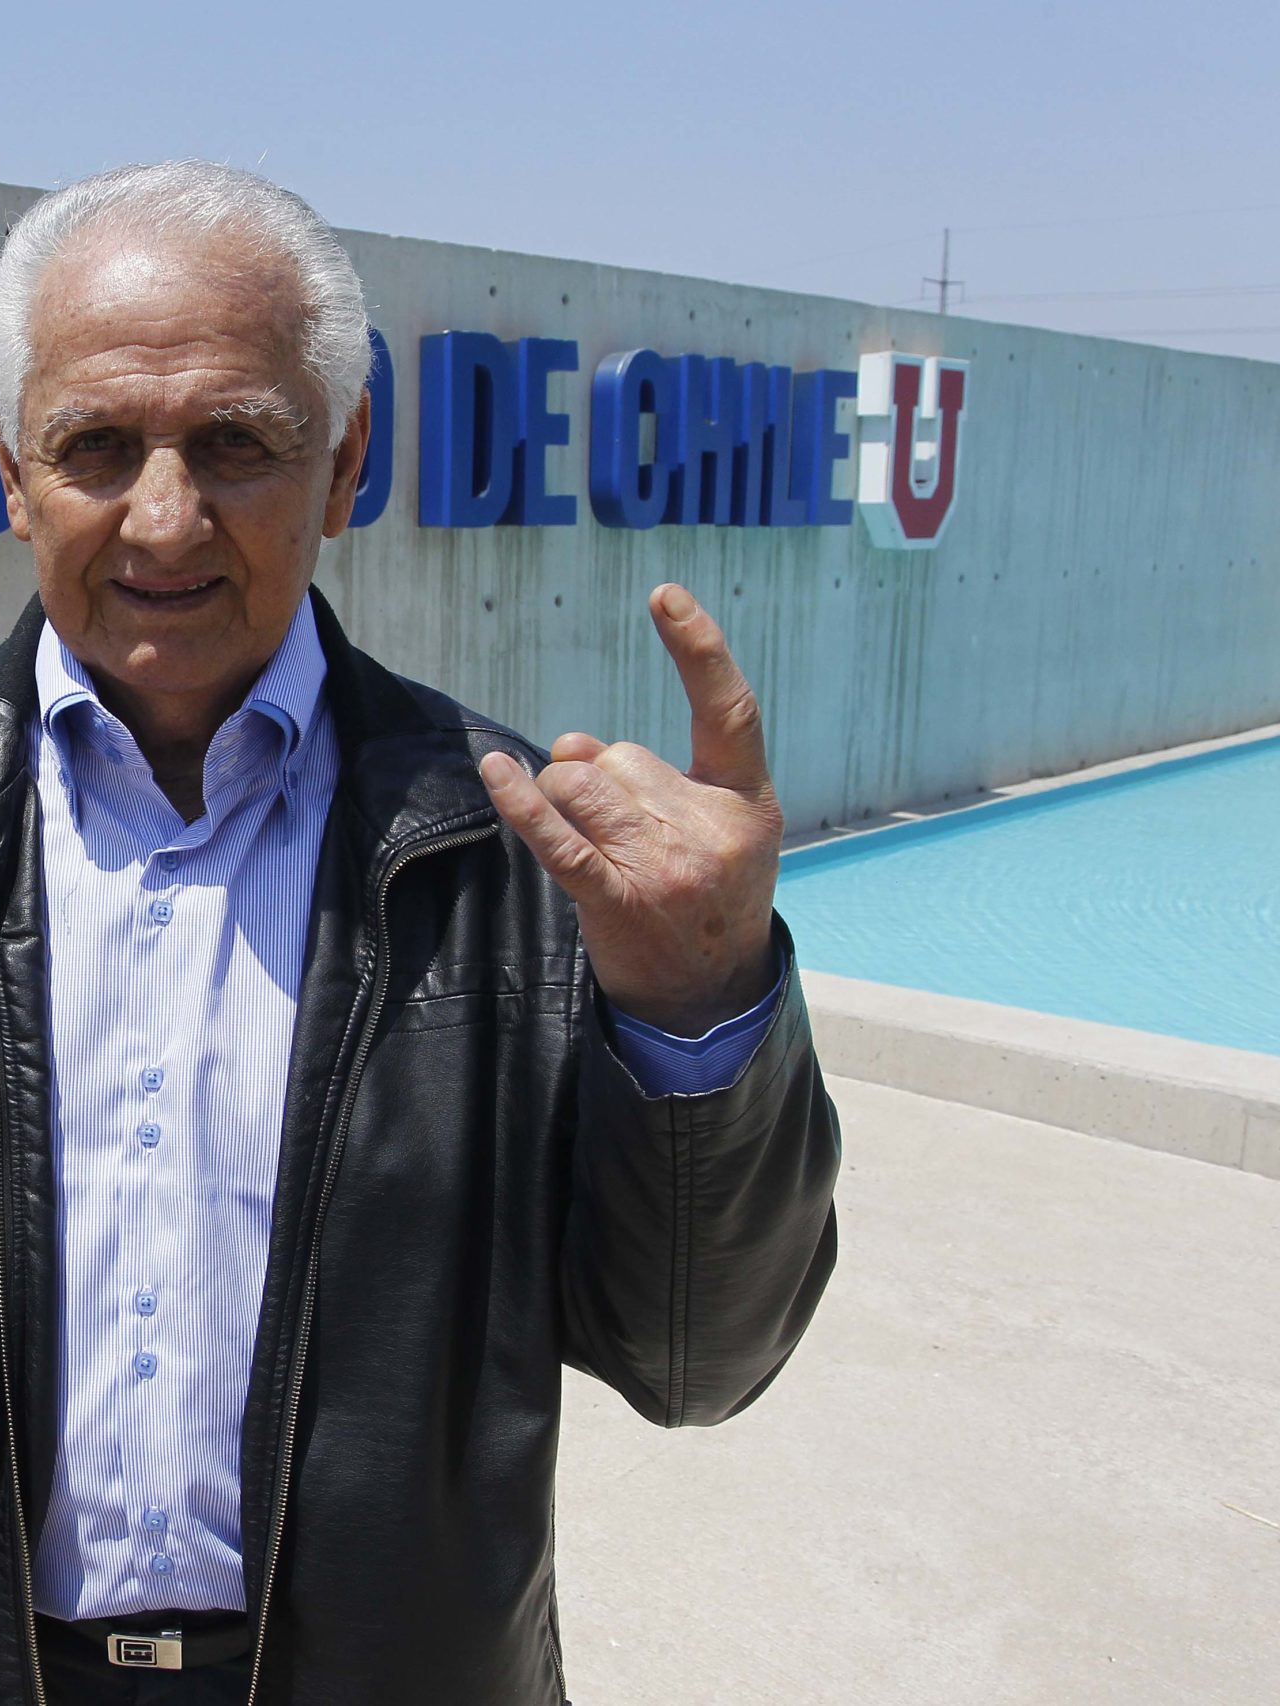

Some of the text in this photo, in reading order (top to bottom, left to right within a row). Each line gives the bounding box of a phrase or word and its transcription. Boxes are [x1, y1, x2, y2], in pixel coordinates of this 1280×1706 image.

[418, 330, 579, 528] DE
[589, 348, 858, 529] CHILE
[857, 351, 971, 551] U
